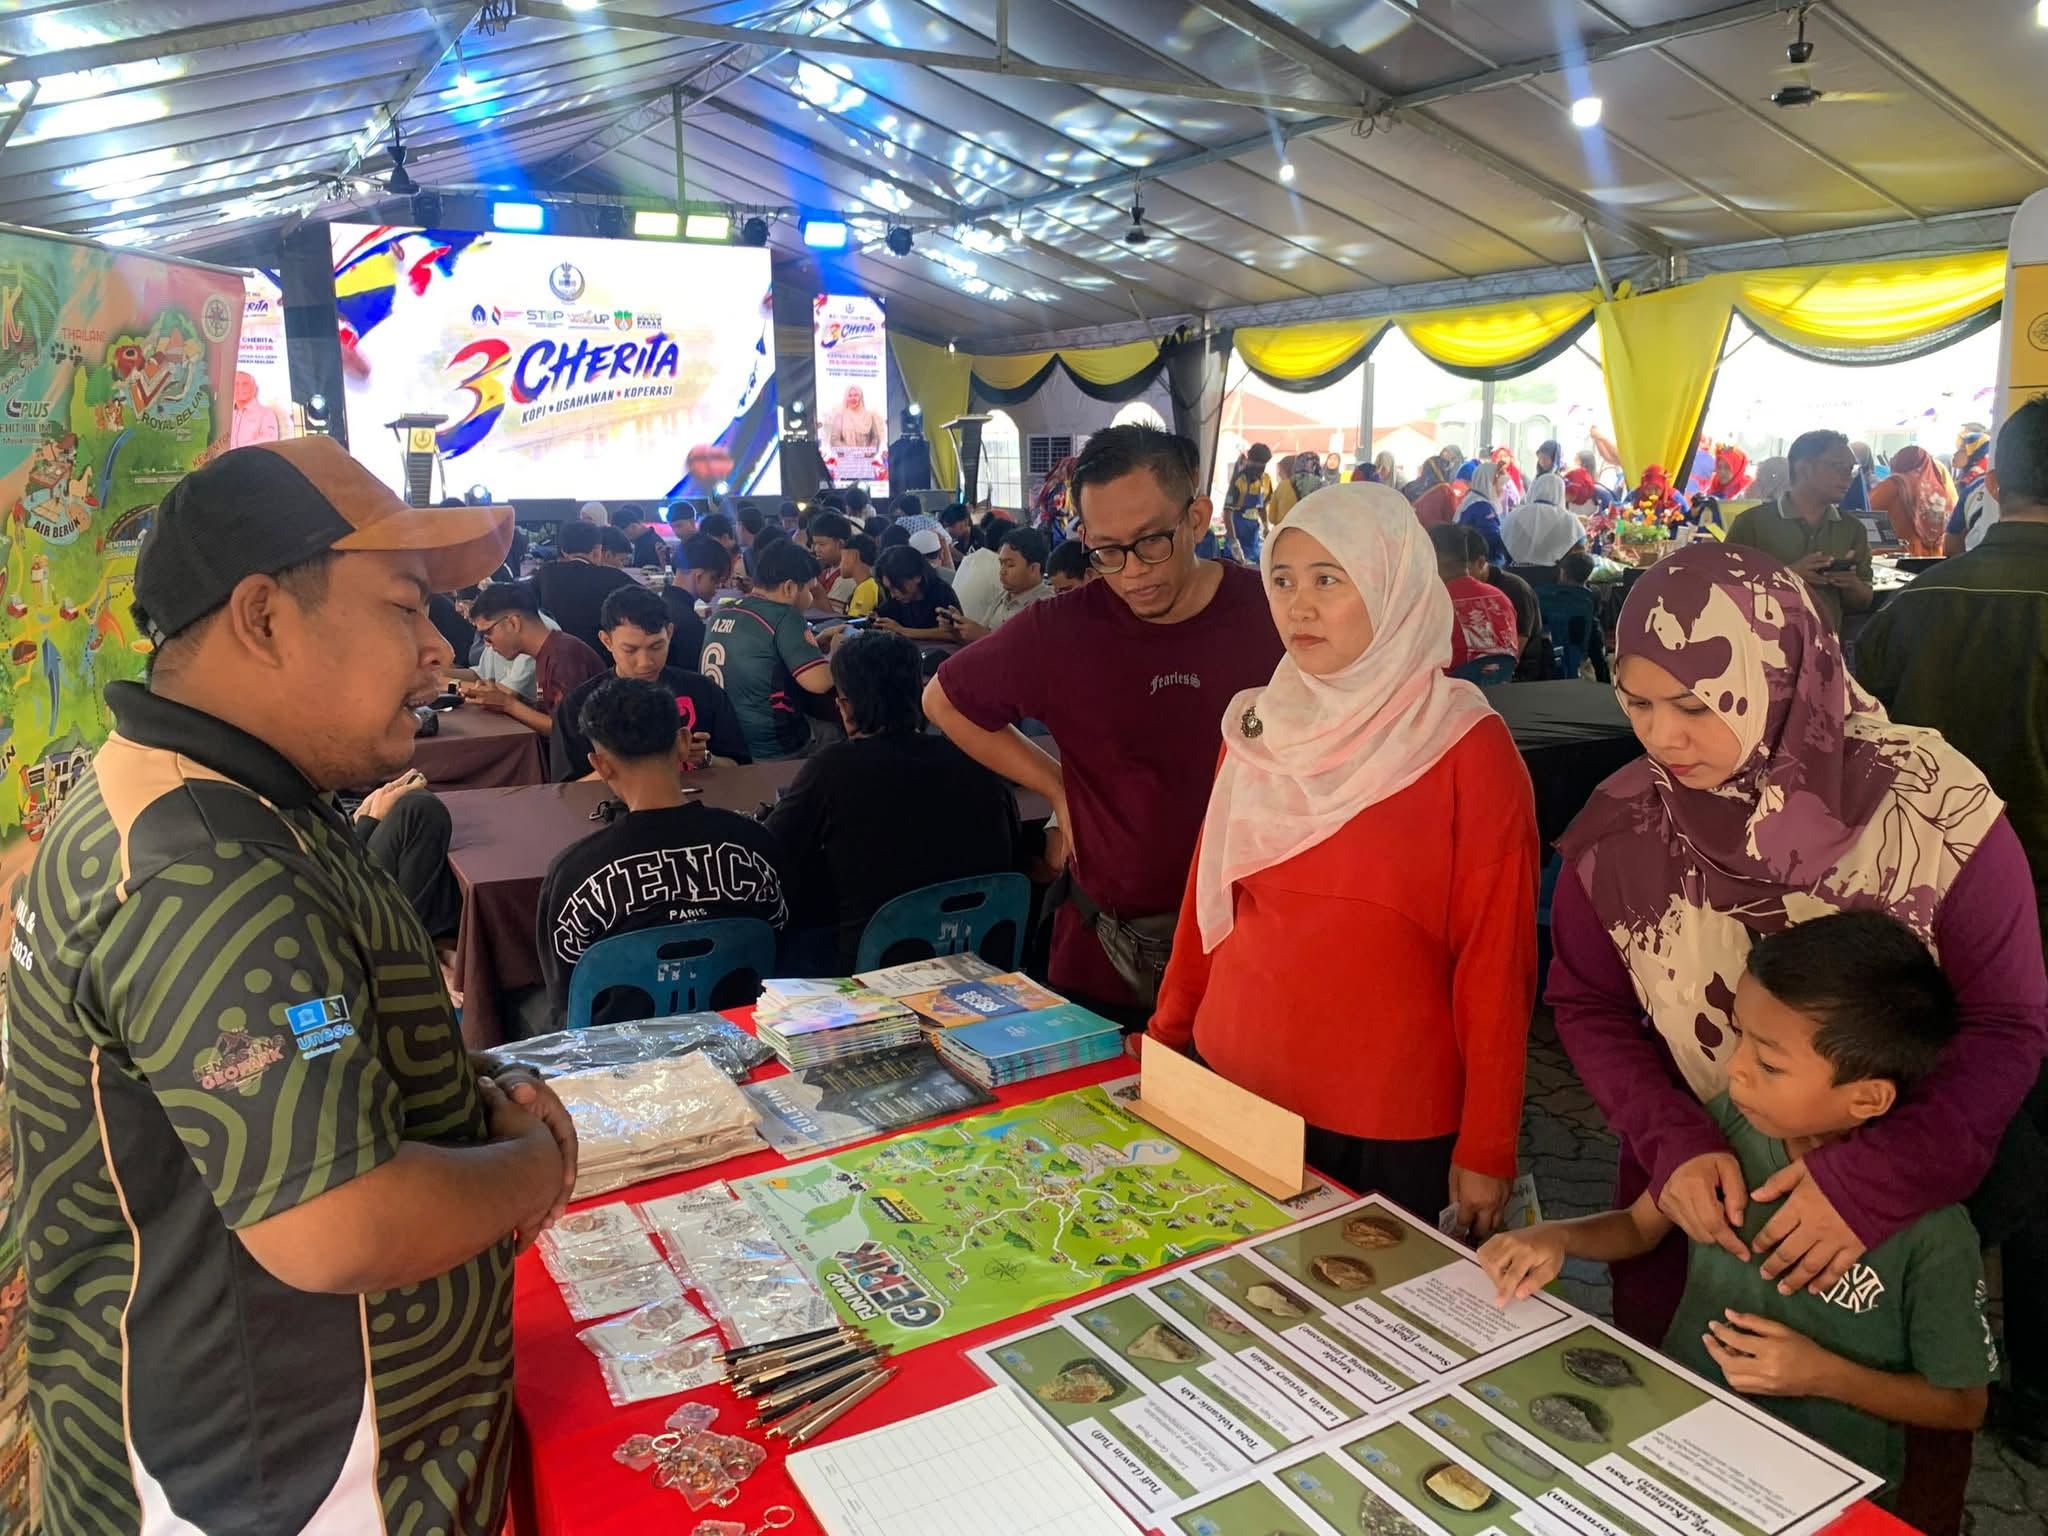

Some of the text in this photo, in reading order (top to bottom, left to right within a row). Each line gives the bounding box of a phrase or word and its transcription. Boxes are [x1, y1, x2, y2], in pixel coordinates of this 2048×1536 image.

[511, 332, 679, 404] CHERITA
[521, 385, 673, 425] KOPI USAHAWAN KOPERASI
[33, 519, 81, 539] AIR BERUK
[711, 618, 736, 633] AZRI
[701, 642, 727, 689] 6
[554, 842, 788, 964] GIVENCH
[766, 1087, 819, 1136] BULETIN
[1249, 1352, 1274, 1373] Basin
[1321, 1349, 1355, 1376] Marble
[1273, 1371, 1308, 1398] Tertiary
[1179, 1386, 1258, 1450] Toba Volcanic Ash
[1308, 1396, 1340, 1422] Lawin
[1112, 1447, 1144, 1480] (Lawin
[1604, 1465, 1634, 1487] Pasu
[1140, 1474, 1162, 1496] Tuff
